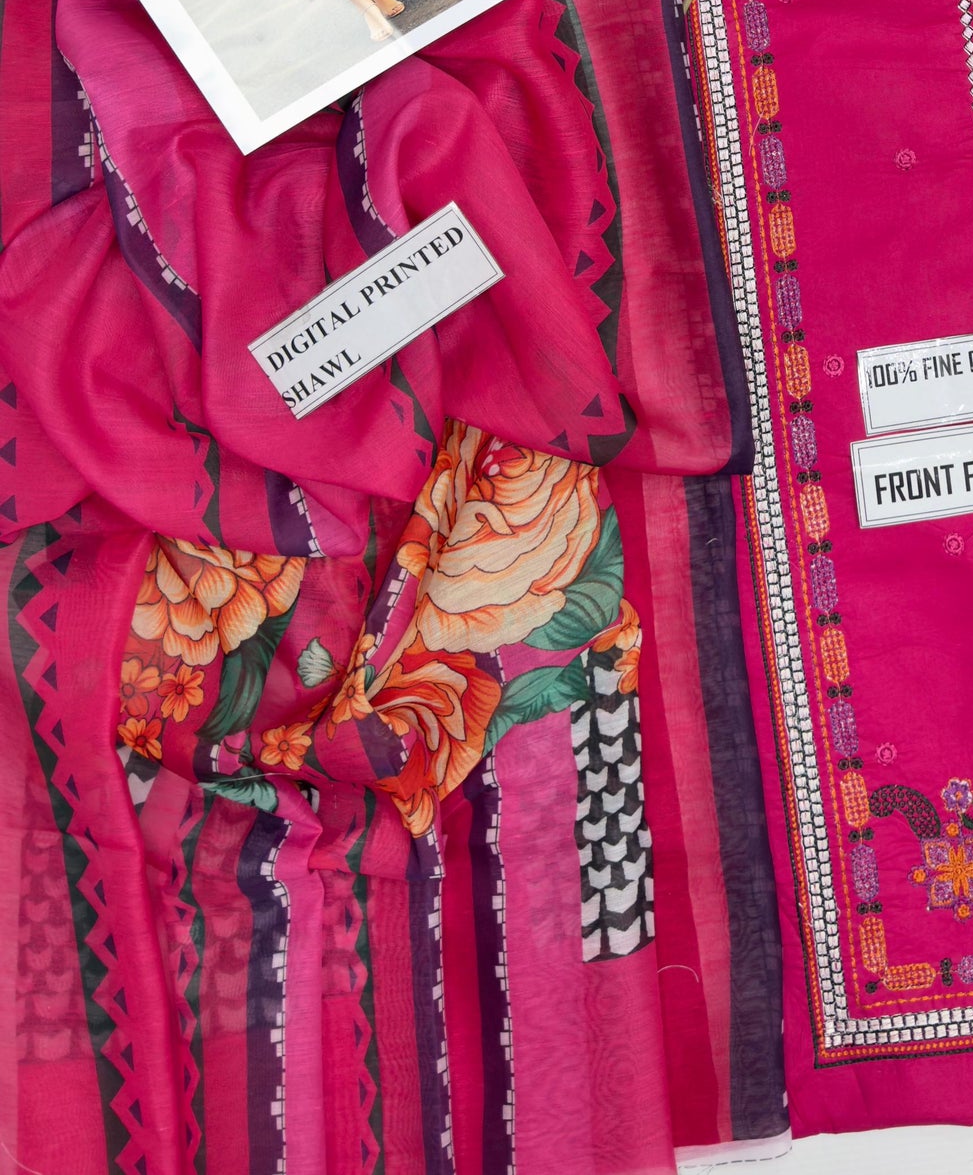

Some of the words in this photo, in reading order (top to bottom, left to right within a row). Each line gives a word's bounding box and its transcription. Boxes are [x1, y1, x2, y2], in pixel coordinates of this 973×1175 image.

[266, 300, 361, 373] DIGITAL
[360, 226, 464, 306] PRINTED
[281, 347, 362, 409] SHAWL
[922, 352, 964, 381] FINE
[874, 463, 955, 505] FRONT
